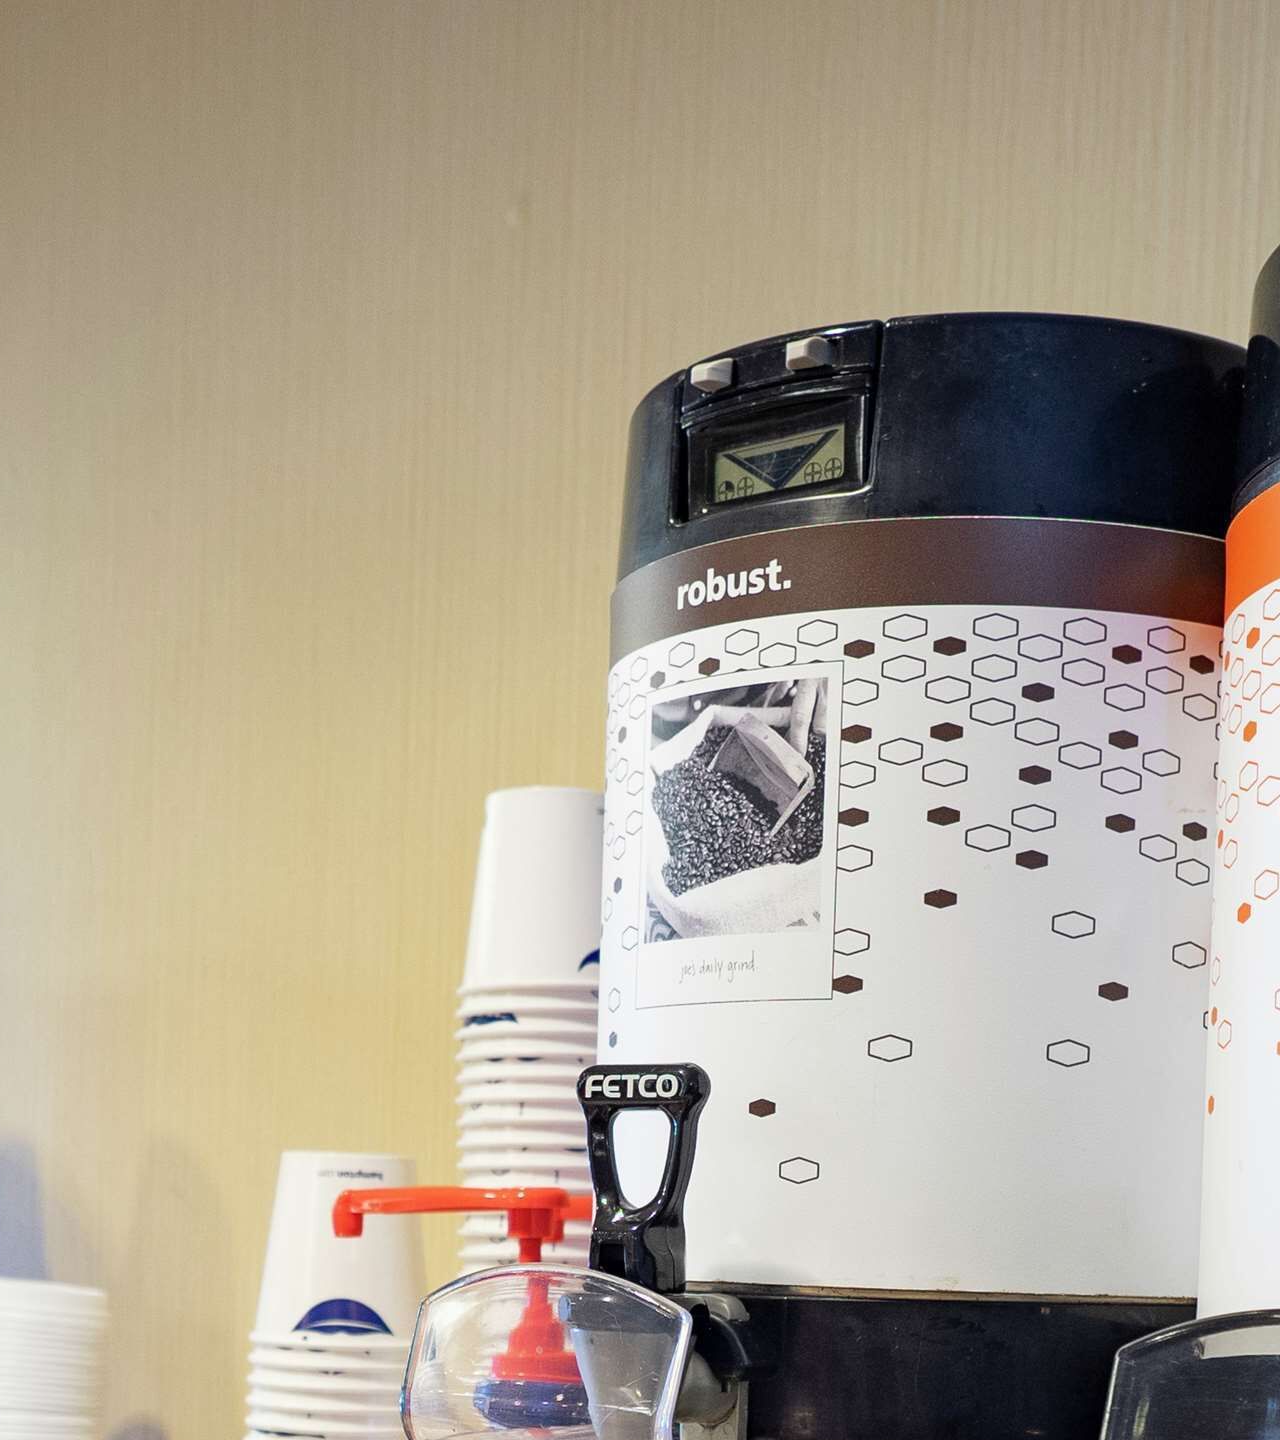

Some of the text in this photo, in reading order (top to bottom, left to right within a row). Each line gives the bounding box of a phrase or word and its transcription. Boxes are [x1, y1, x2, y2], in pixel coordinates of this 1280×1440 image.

[676, 558, 792, 611] robust.
[698, 957, 724, 980] daily
[584, 1073, 679, 1098] FETCO
